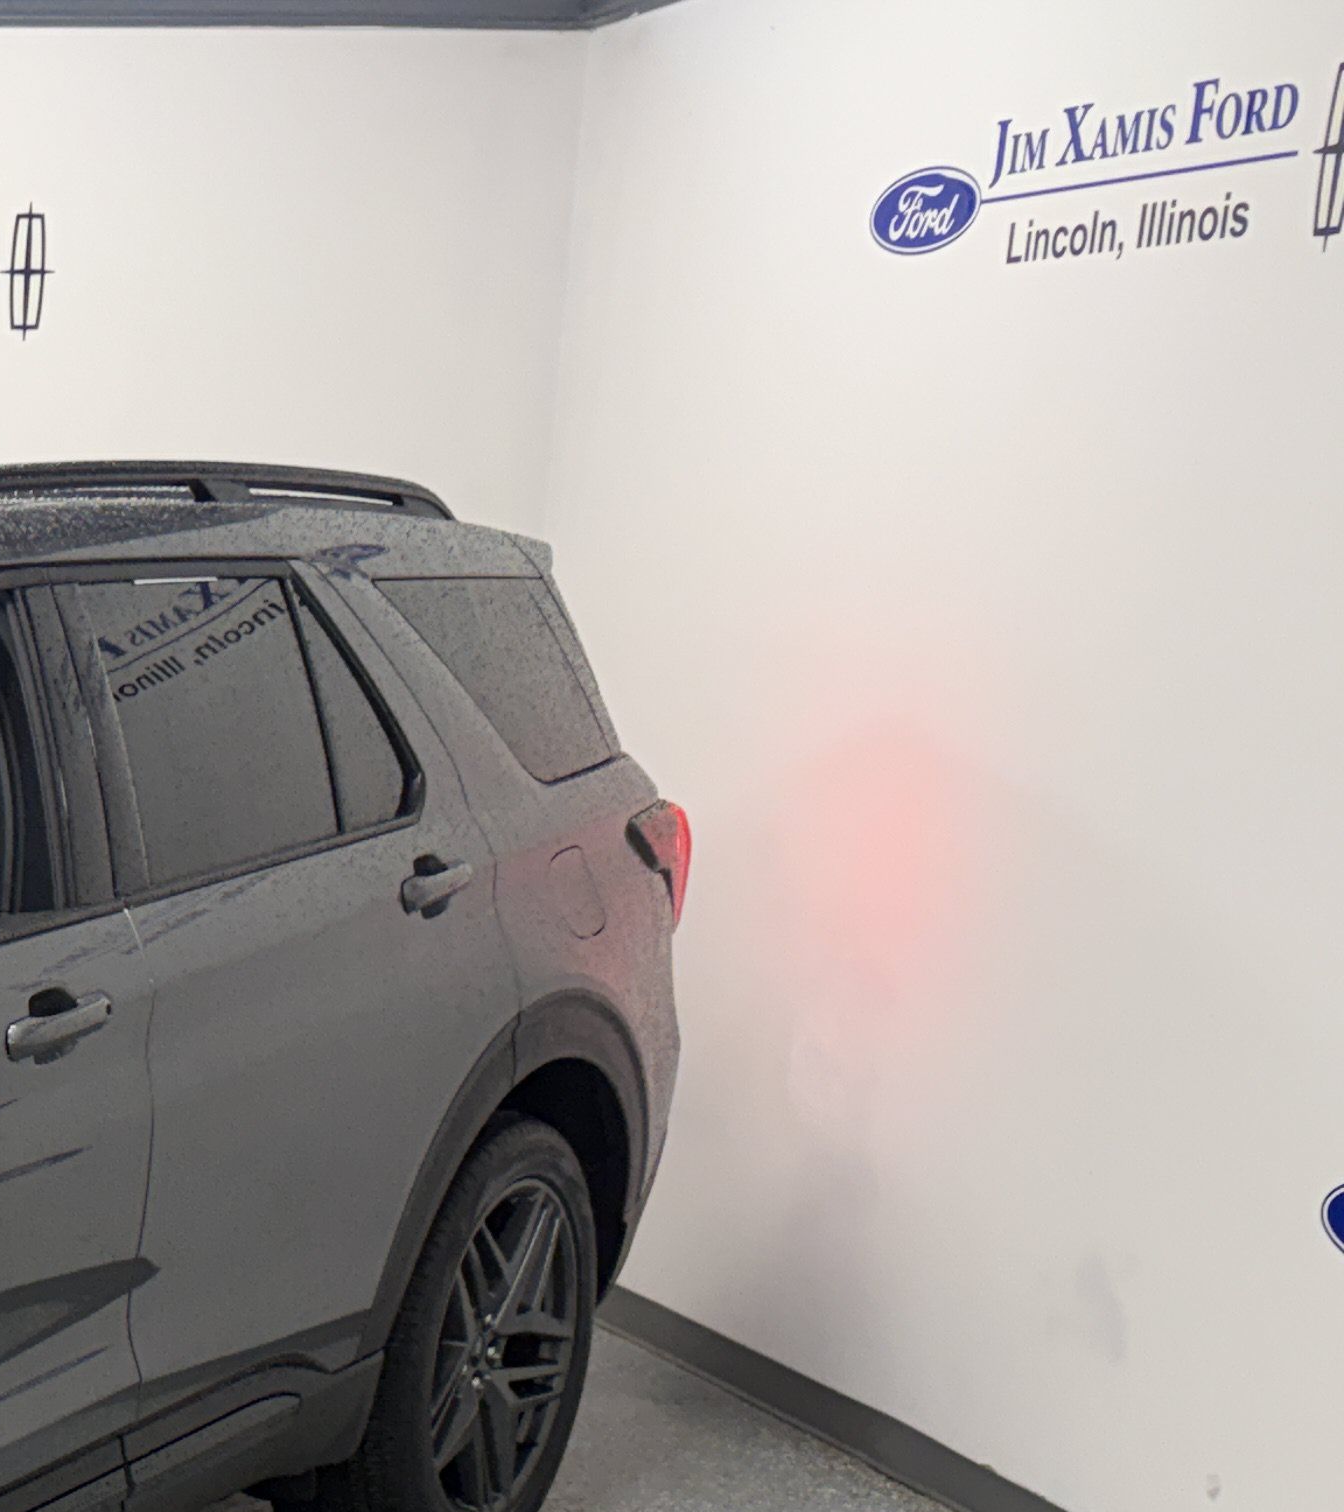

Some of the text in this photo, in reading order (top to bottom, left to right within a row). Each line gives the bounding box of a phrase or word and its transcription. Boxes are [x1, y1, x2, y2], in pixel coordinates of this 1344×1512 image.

[989, 77, 1300, 189] JIM XAMIS FORD
[888, 184, 961, 240] Ford
[1005, 191, 1251, 265] Lincoln, Illinois
